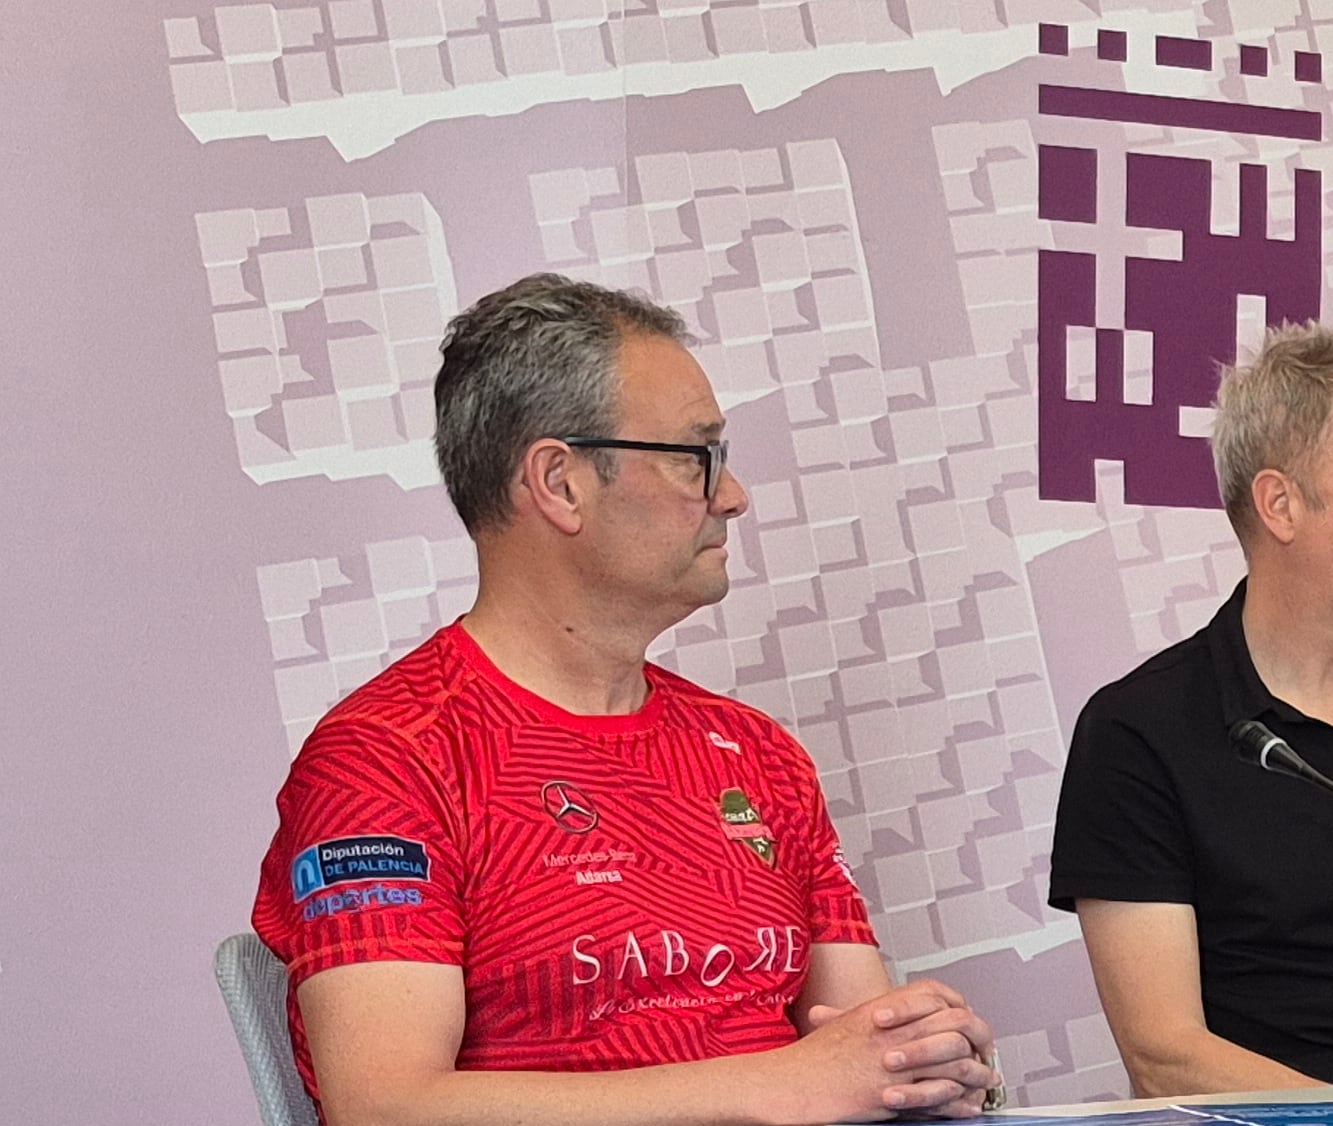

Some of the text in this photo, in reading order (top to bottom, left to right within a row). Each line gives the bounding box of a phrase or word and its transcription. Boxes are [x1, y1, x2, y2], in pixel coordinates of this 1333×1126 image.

[322, 842, 404, 861] Diputación
[324, 859, 424, 877] DE PALENCIA
